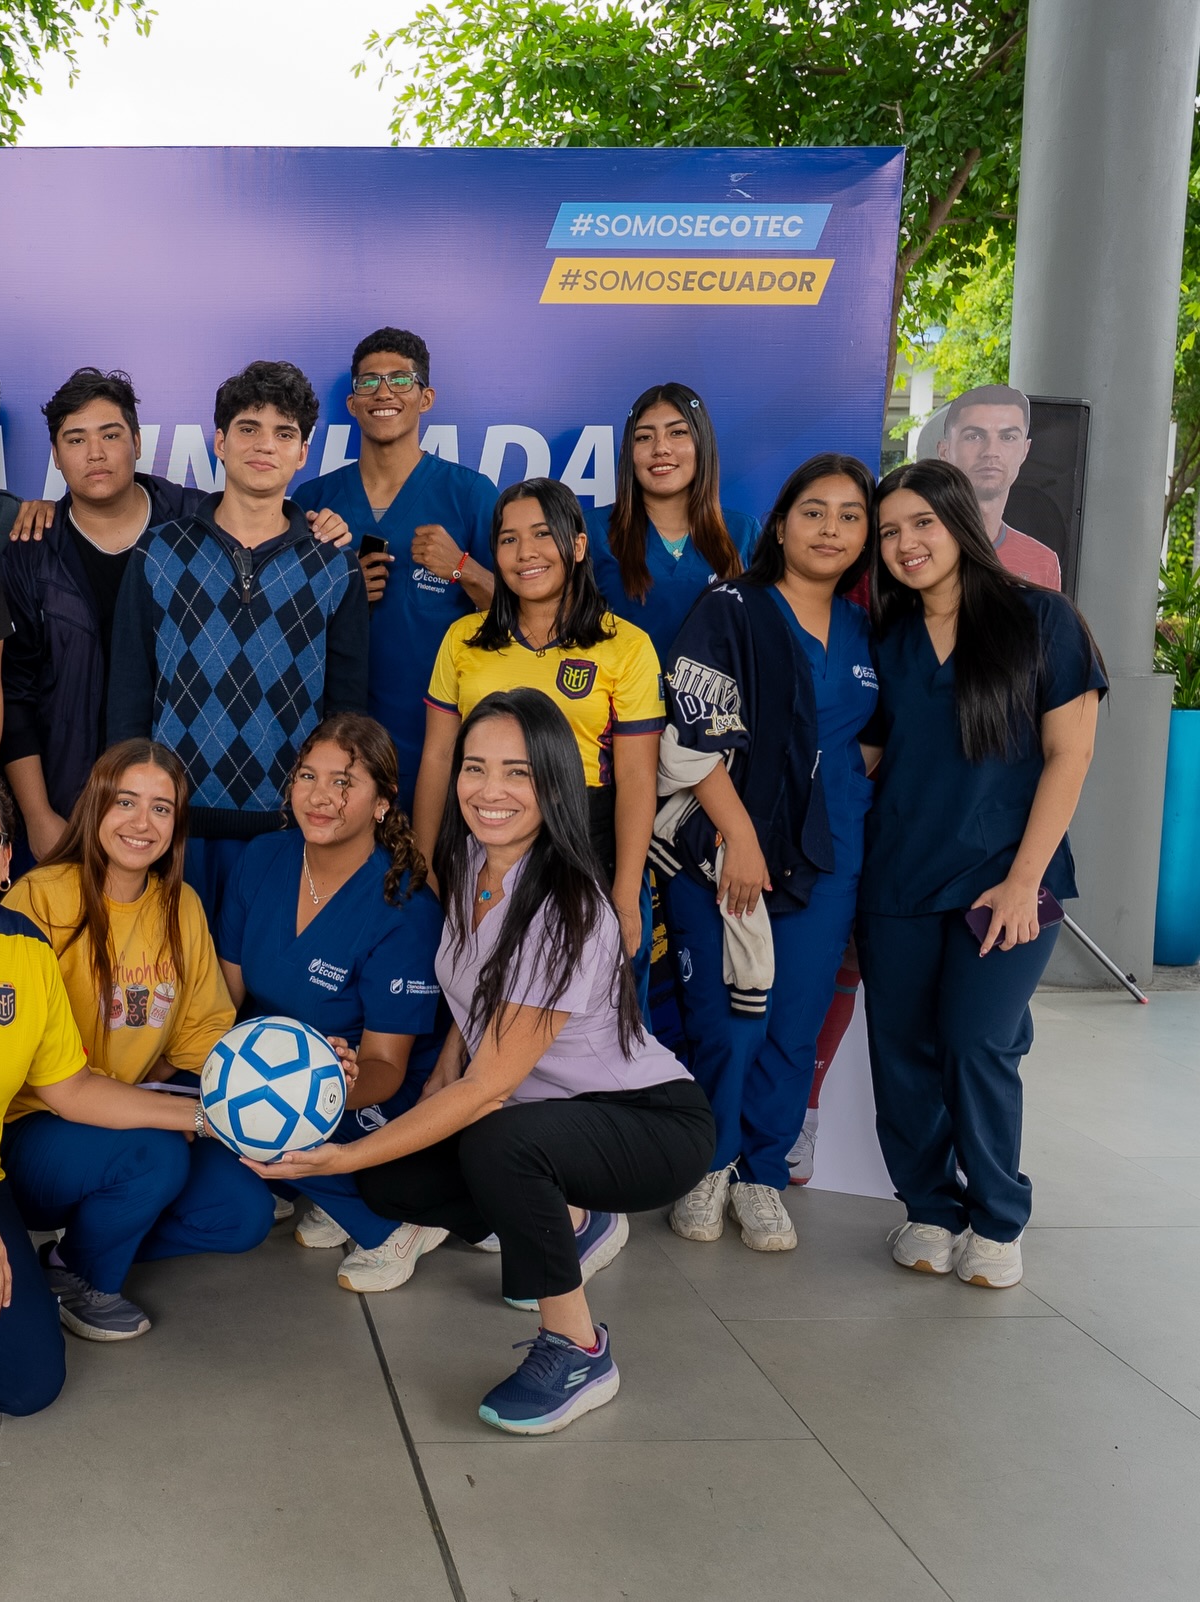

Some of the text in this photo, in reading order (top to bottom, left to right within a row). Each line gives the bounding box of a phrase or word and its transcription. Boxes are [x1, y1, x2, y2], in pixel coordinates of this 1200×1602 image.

[569, 213, 804, 238] #SOMOSECOTEC
[558, 268, 816, 292] #SOMOSECUADOR
[309, 975, 338, 992] Fisioterapia
[319, 966, 345, 982] Ecotec
